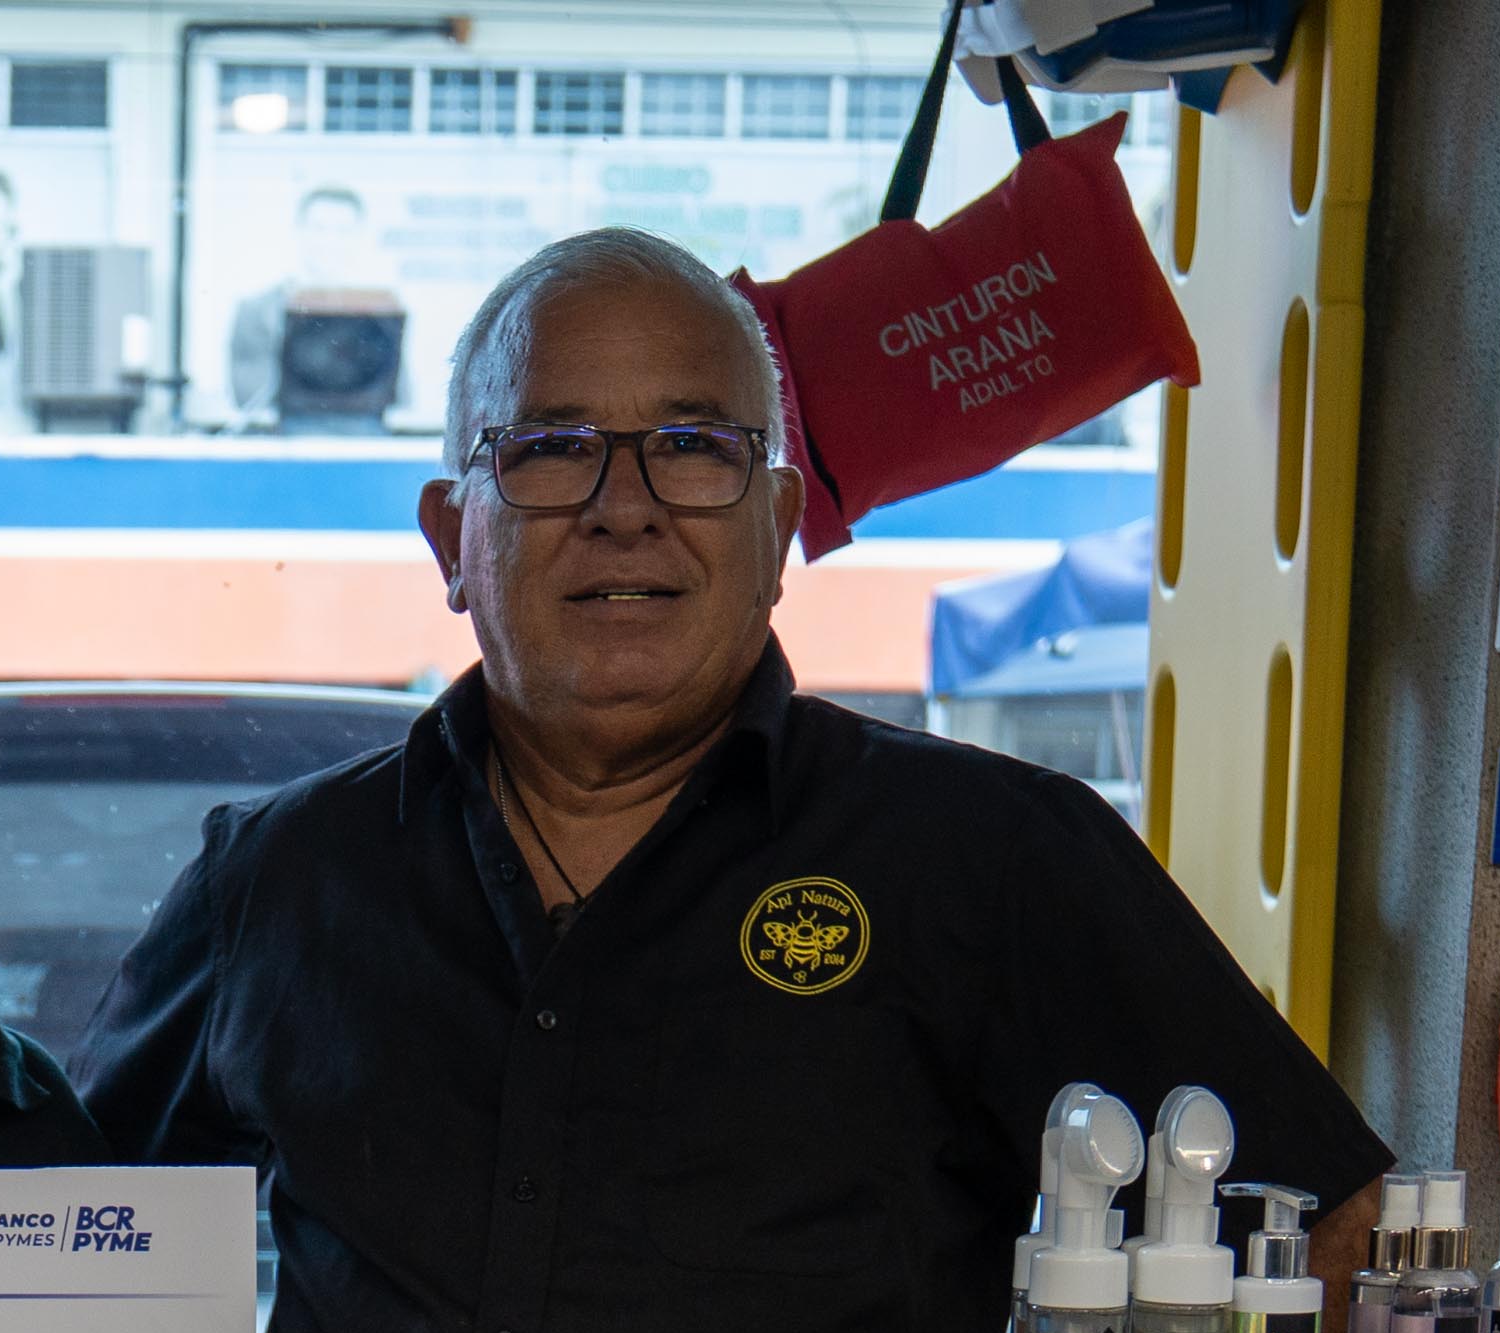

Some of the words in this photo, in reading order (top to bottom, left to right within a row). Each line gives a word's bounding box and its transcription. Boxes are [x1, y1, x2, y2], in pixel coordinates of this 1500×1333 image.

[879, 251, 1057, 358] CINTURON
[928, 309, 1056, 391] ARAÑA
[960, 354, 1055, 413] ADULTO
[801, 890, 851, 917] Natura
[76, 1206, 135, 1231] BCR
[72, 1232, 152, 1252] PYME
